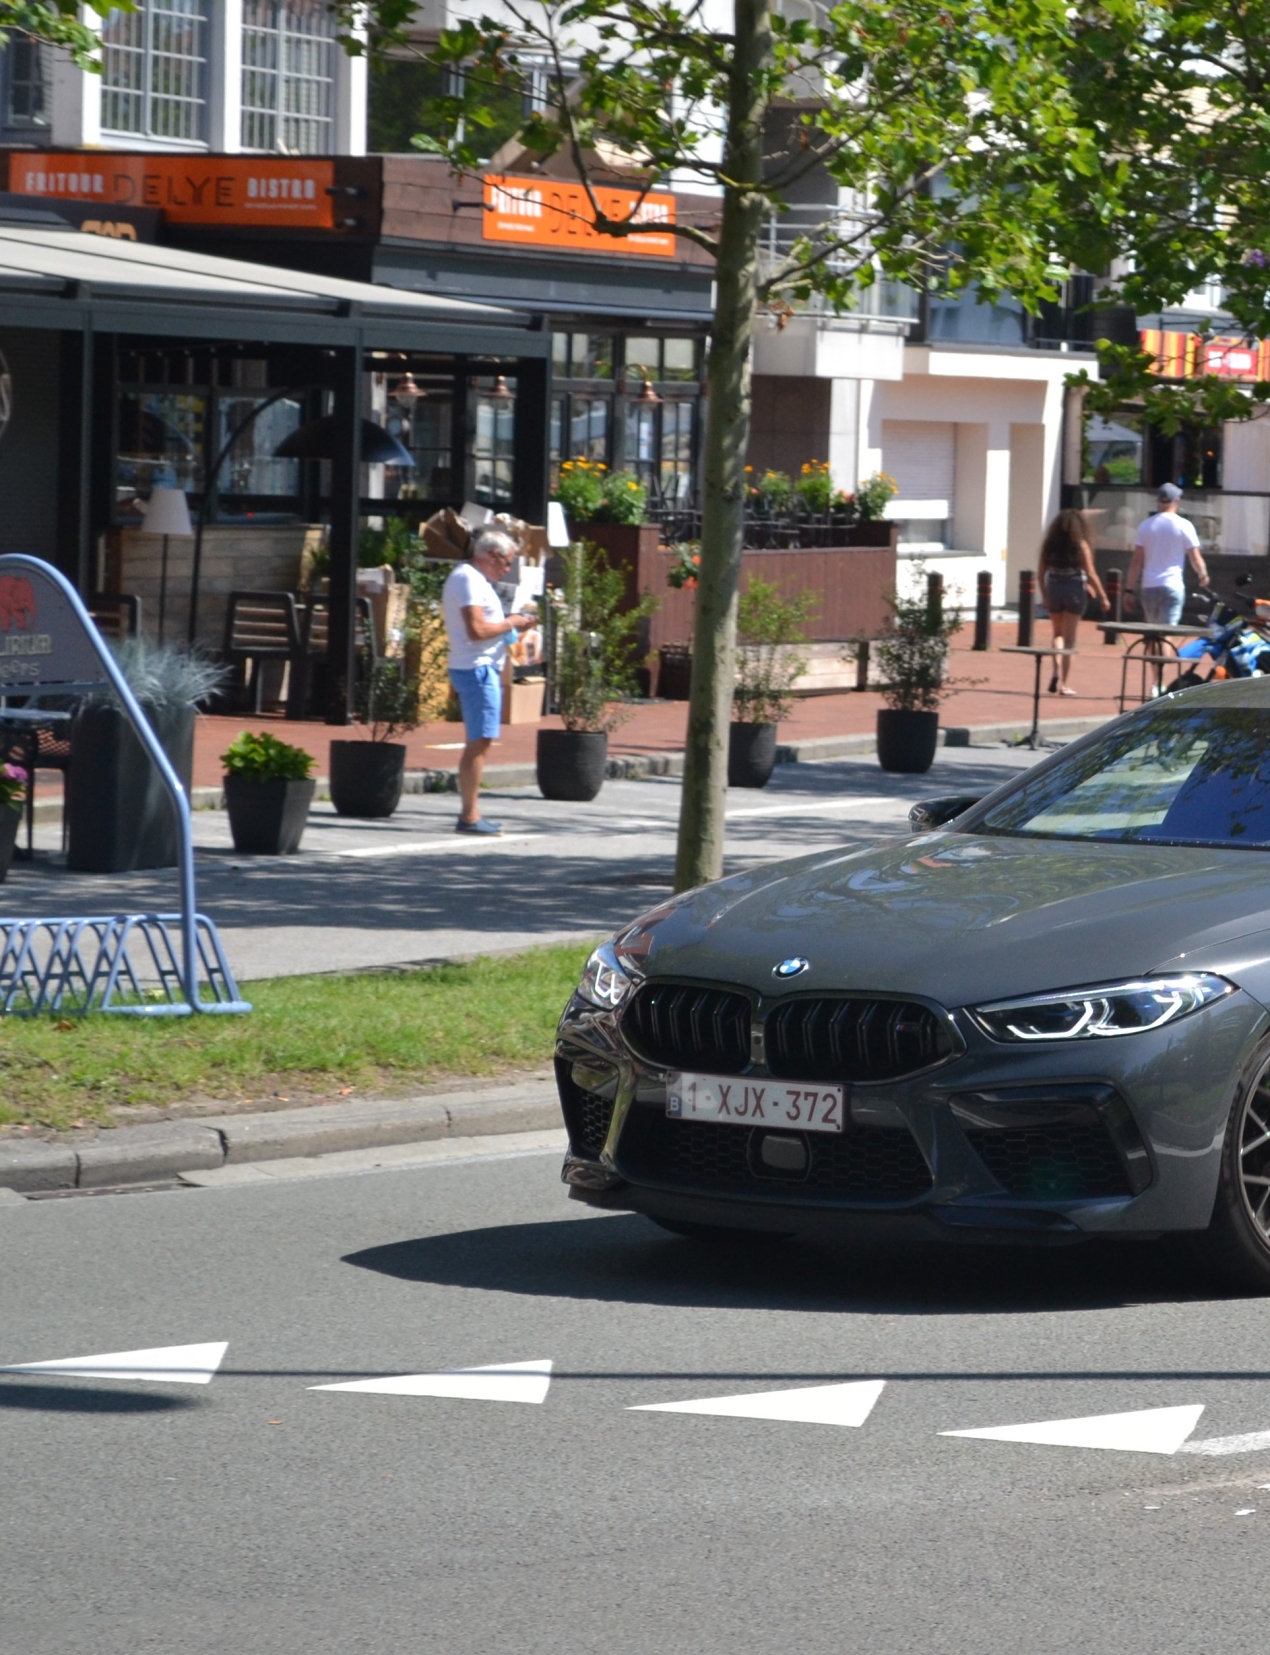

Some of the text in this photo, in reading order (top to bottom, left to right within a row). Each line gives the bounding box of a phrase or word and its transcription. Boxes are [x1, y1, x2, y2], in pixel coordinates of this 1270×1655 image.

[113, 174, 236, 207] DELYE
[247, 177, 316, 199] BISTRO
[669, 1096, 680, 1112] B
